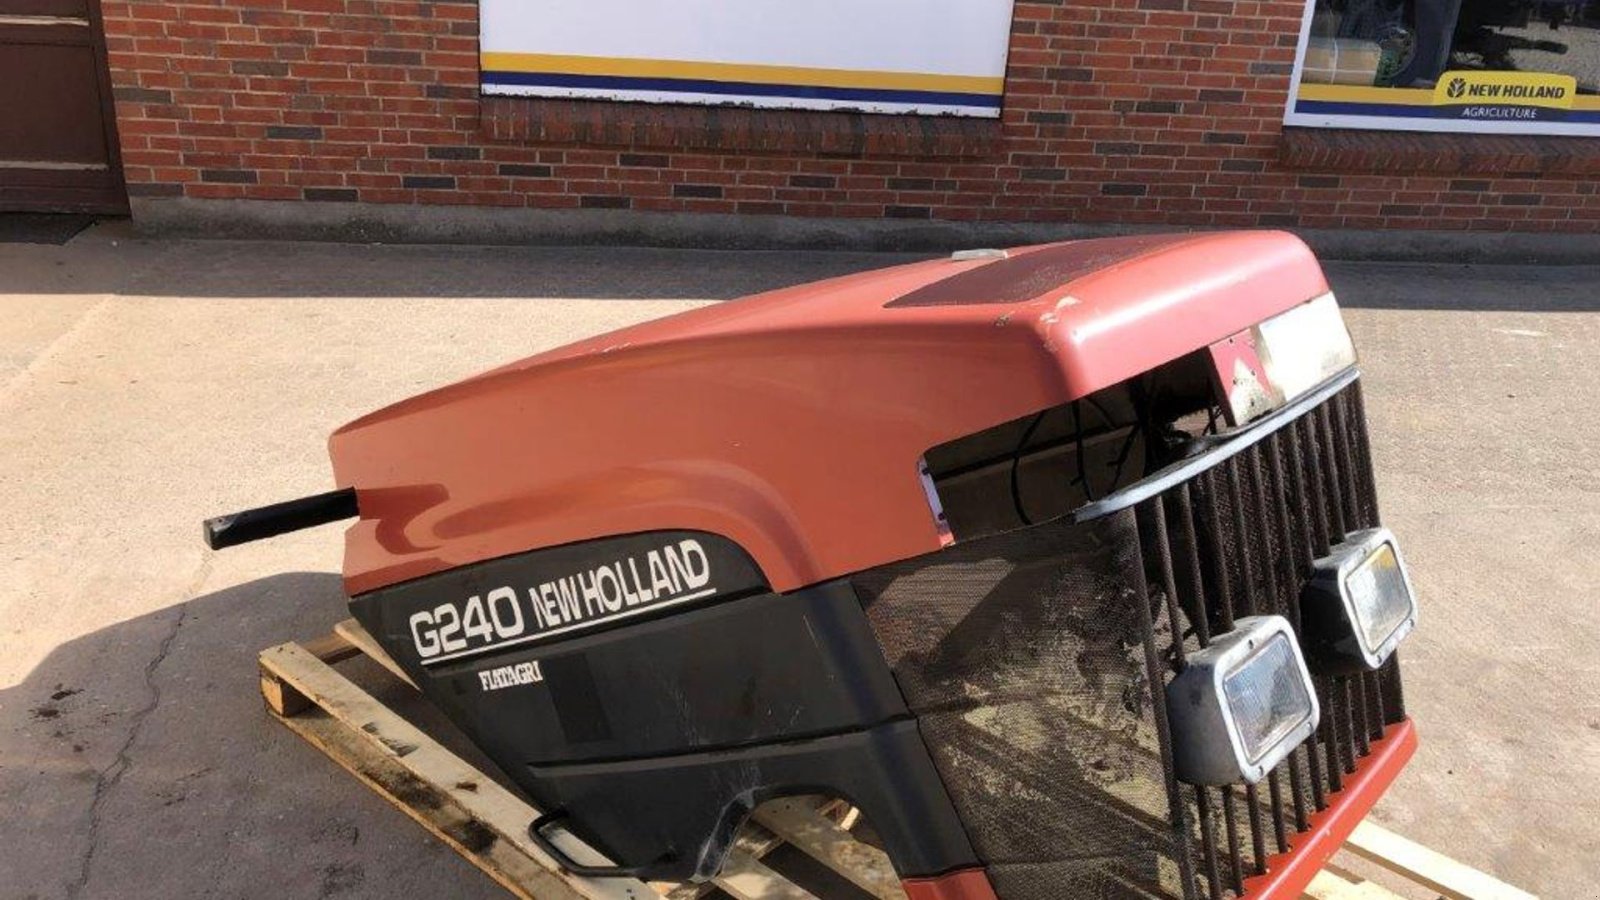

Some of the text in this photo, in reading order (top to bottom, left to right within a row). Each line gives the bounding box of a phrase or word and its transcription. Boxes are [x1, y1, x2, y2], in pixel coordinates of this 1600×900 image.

[1468, 84, 1565, 99] NEW HOLLAND
[1462, 107, 1537, 119] AGRICULTURE
[409, 539, 710, 658] G240 NEW HOLLAND
[478, 660, 543, 691] FIATAGRI
